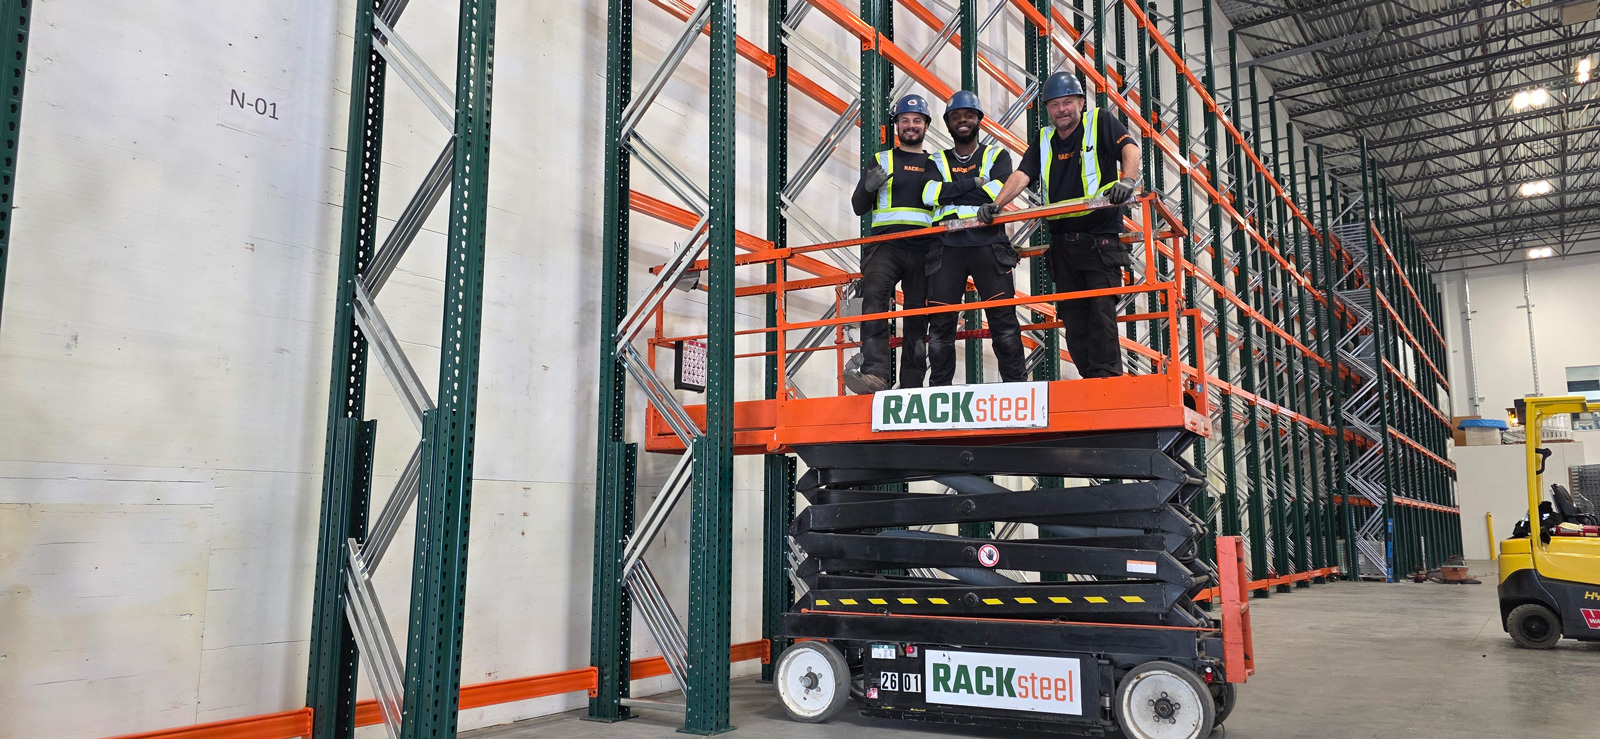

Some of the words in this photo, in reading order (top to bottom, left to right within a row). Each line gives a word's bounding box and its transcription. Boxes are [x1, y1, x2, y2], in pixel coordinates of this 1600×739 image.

[230, 88, 279, 120] N-01
[882, 387, 1035, 425] RACKsteel
[882, 673, 897, 690] 26
[904, 674, 919, 691] 01
[932, 662, 1074, 702] RACKsteel
